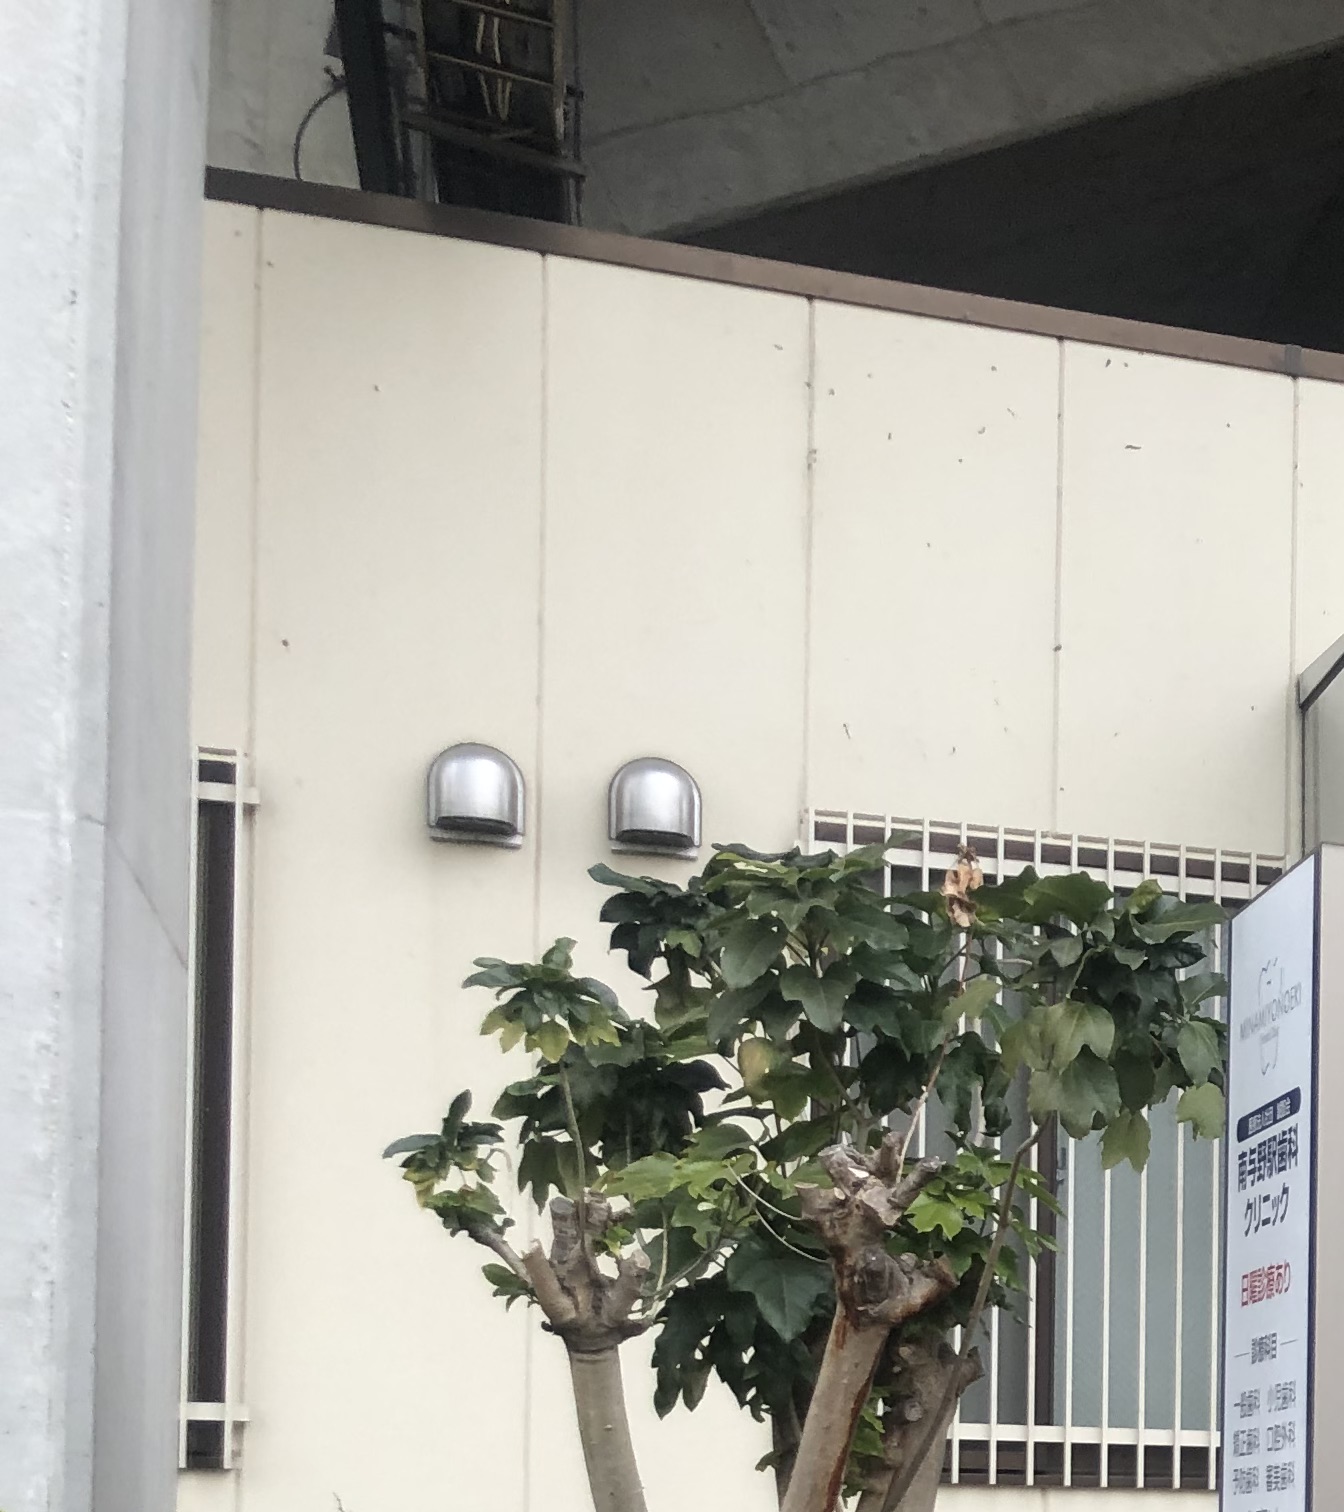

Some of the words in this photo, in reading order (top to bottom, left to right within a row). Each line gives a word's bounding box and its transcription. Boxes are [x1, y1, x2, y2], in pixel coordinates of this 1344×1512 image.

[1237, 1123, 1299, 1193] 南与野駅歯科
[1244, 1182, 1290, 1238] クリニック
